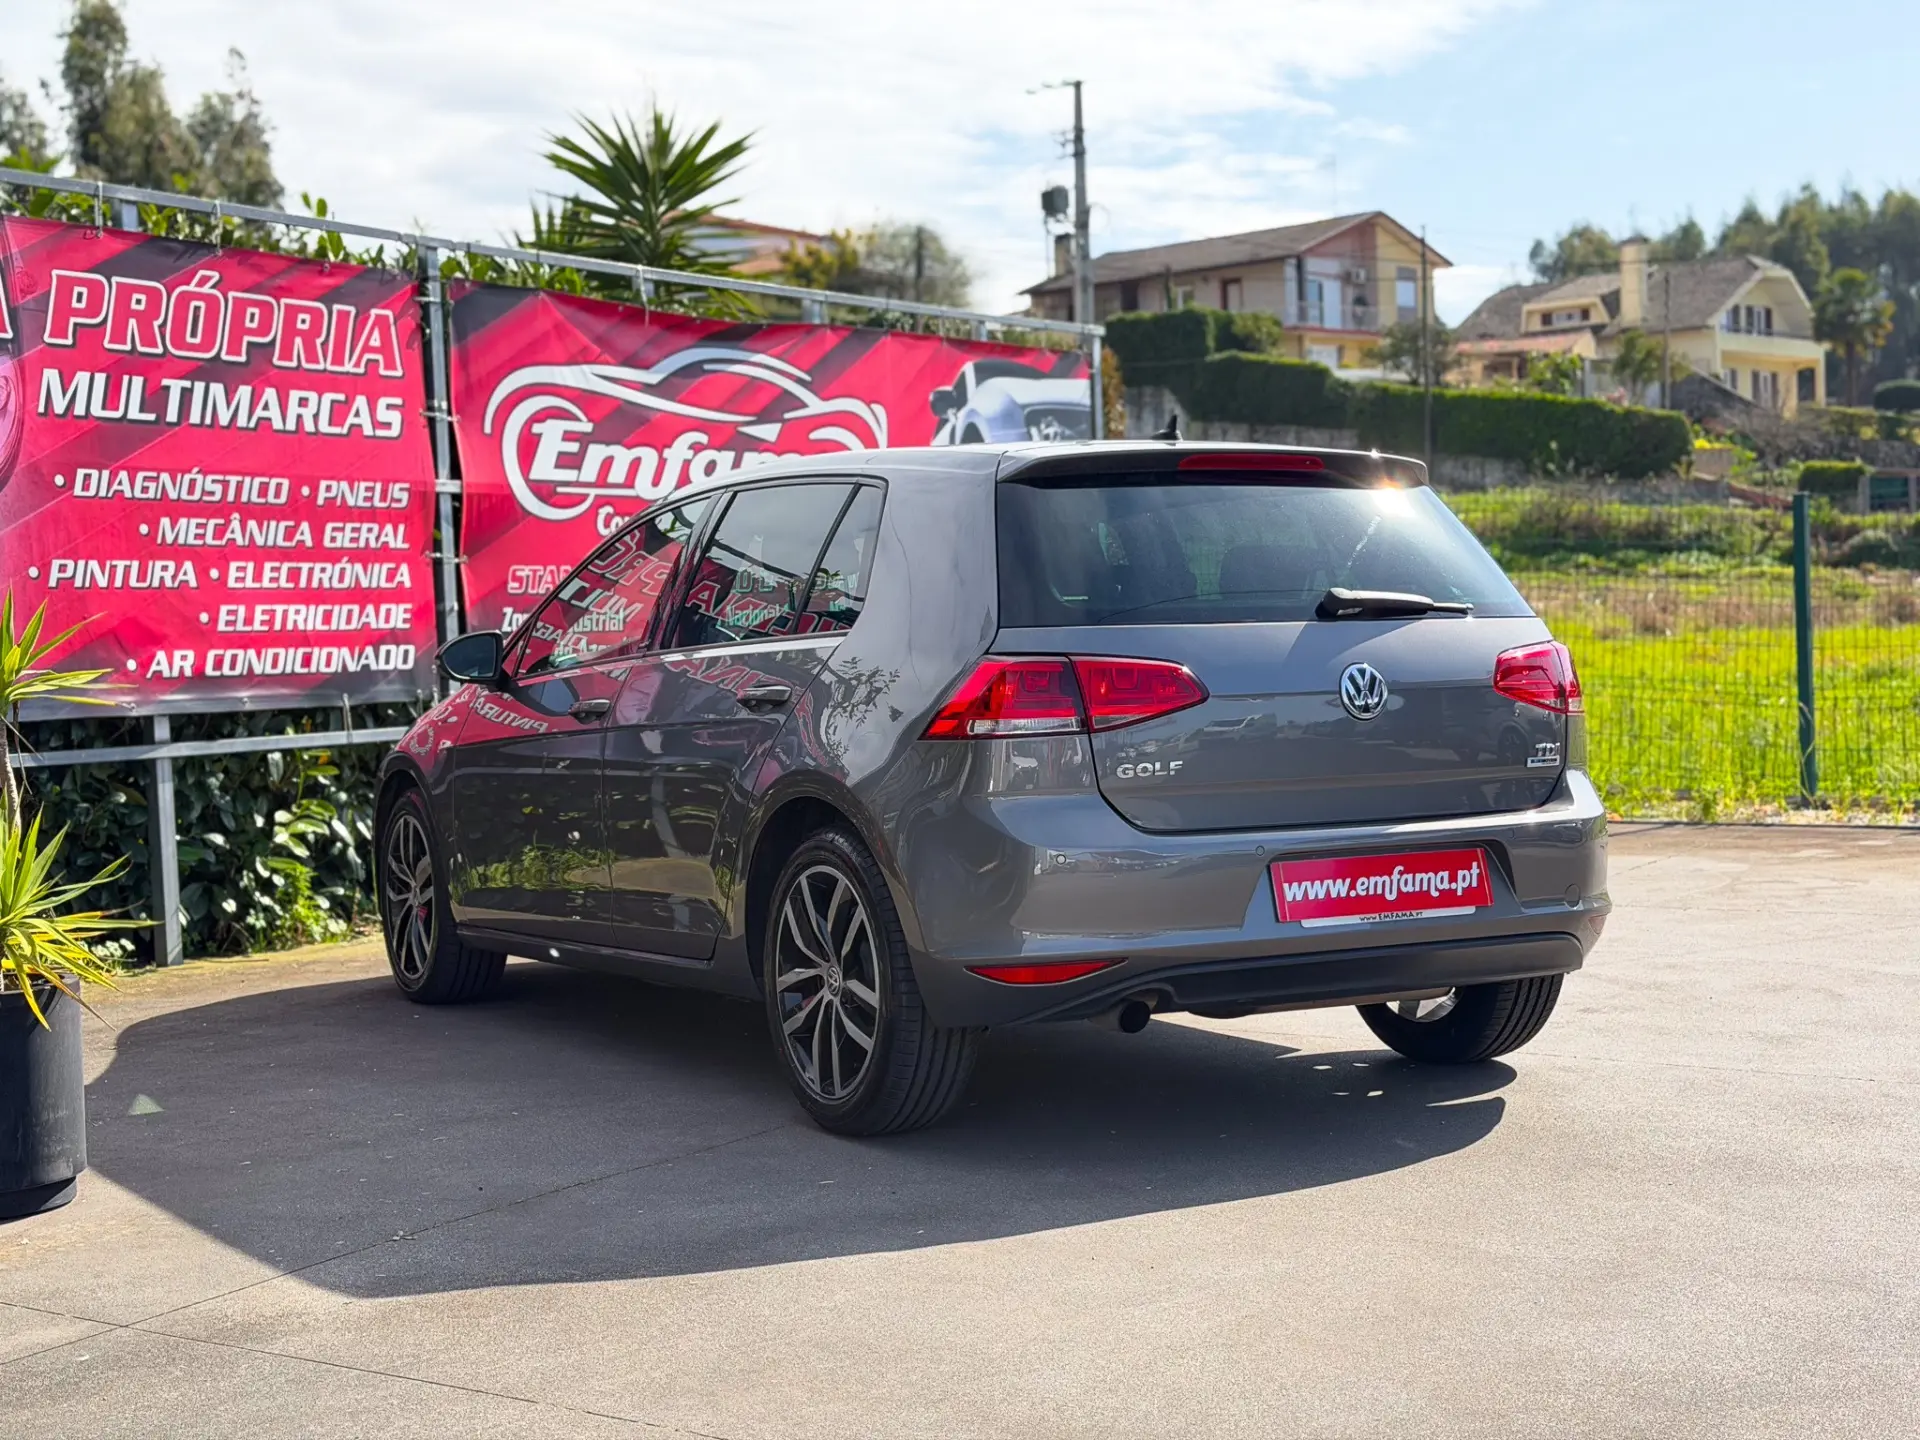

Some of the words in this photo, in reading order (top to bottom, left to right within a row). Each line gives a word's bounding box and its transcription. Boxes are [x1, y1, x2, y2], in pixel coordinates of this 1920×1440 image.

[44, 269, 403, 376] PRÓPRIA
[37, 368, 403, 439] MULTIMARCAS
[528, 418, 805, 500] Emfa
[72, 467, 290, 505] DIAGNÓSTICO
[316, 480, 411, 509] PNEUS
[156, 512, 313, 549] MECÂNICA
[322, 521, 411, 549] GERAL
[48, 559, 198, 588] PINTURA
[227, 557, 412, 589] ELECTRÓNICA
[217, 603, 412, 633] ELETRICIDADE
[146, 650, 195, 679] AR
[204, 644, 415, 677] CONDICIONADO
[1116, 759, 1184, 779] GOLF
[1282, 861, 1481, 903] www.emfama.pt
